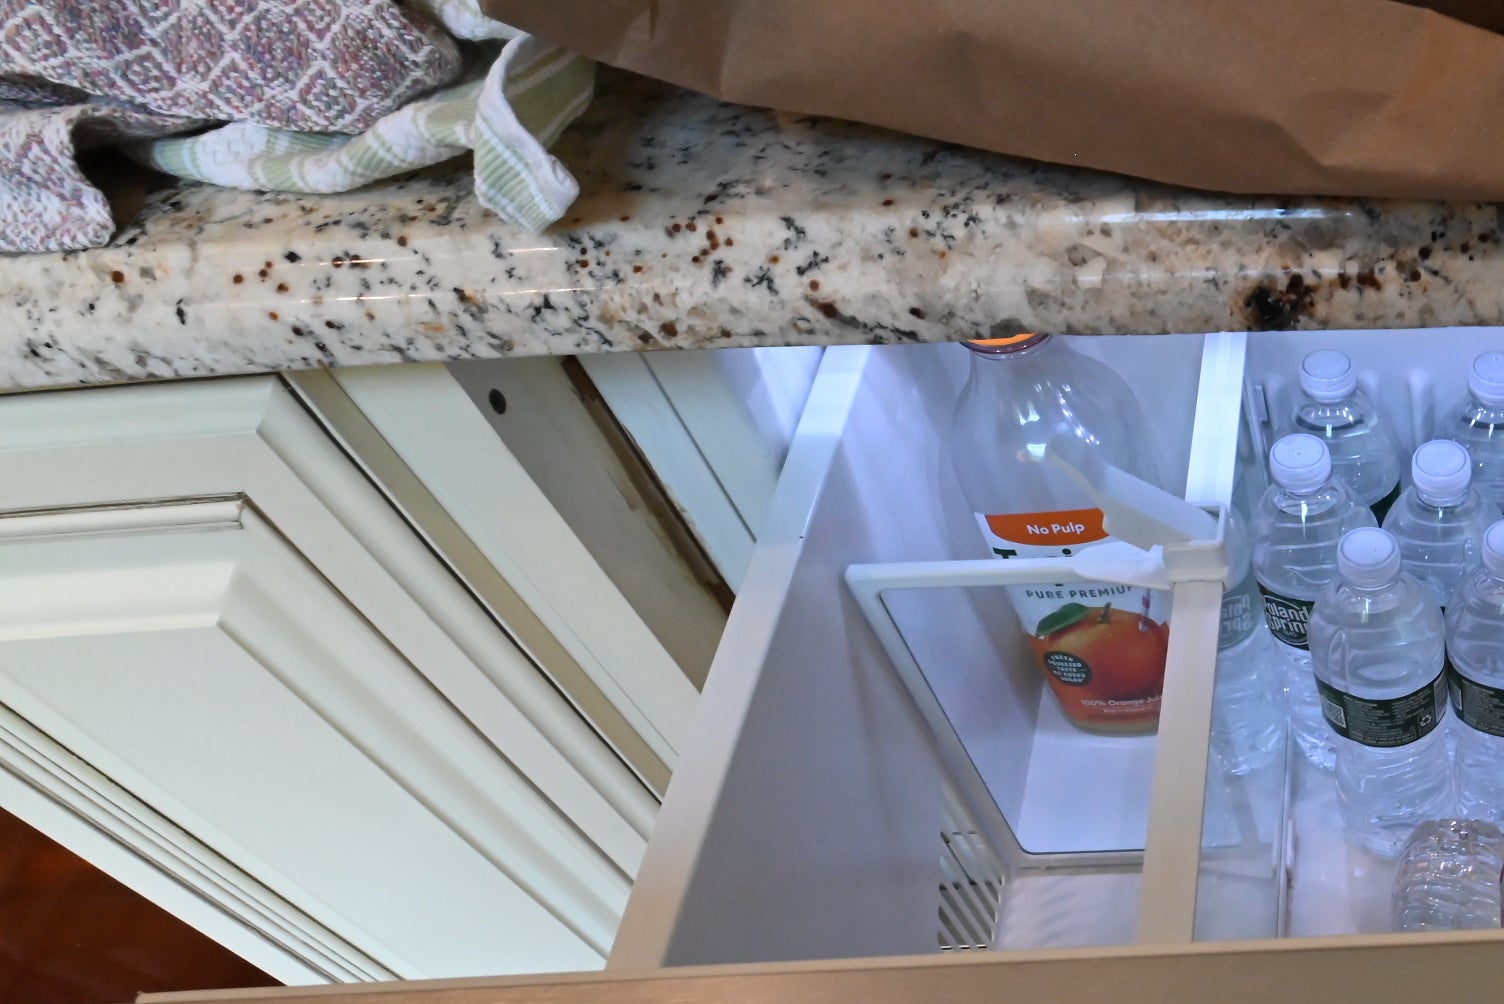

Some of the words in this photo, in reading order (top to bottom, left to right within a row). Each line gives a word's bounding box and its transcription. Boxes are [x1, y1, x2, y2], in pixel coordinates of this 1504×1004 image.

[1027, 524, 1049, 535] No
[1051, 522, 1085, 535] Pulp
[1025, 590, 1064, 599] PURE
[1264, 602, 1308, 623] oland
[1265, 611, 1308, 634] Sprin
